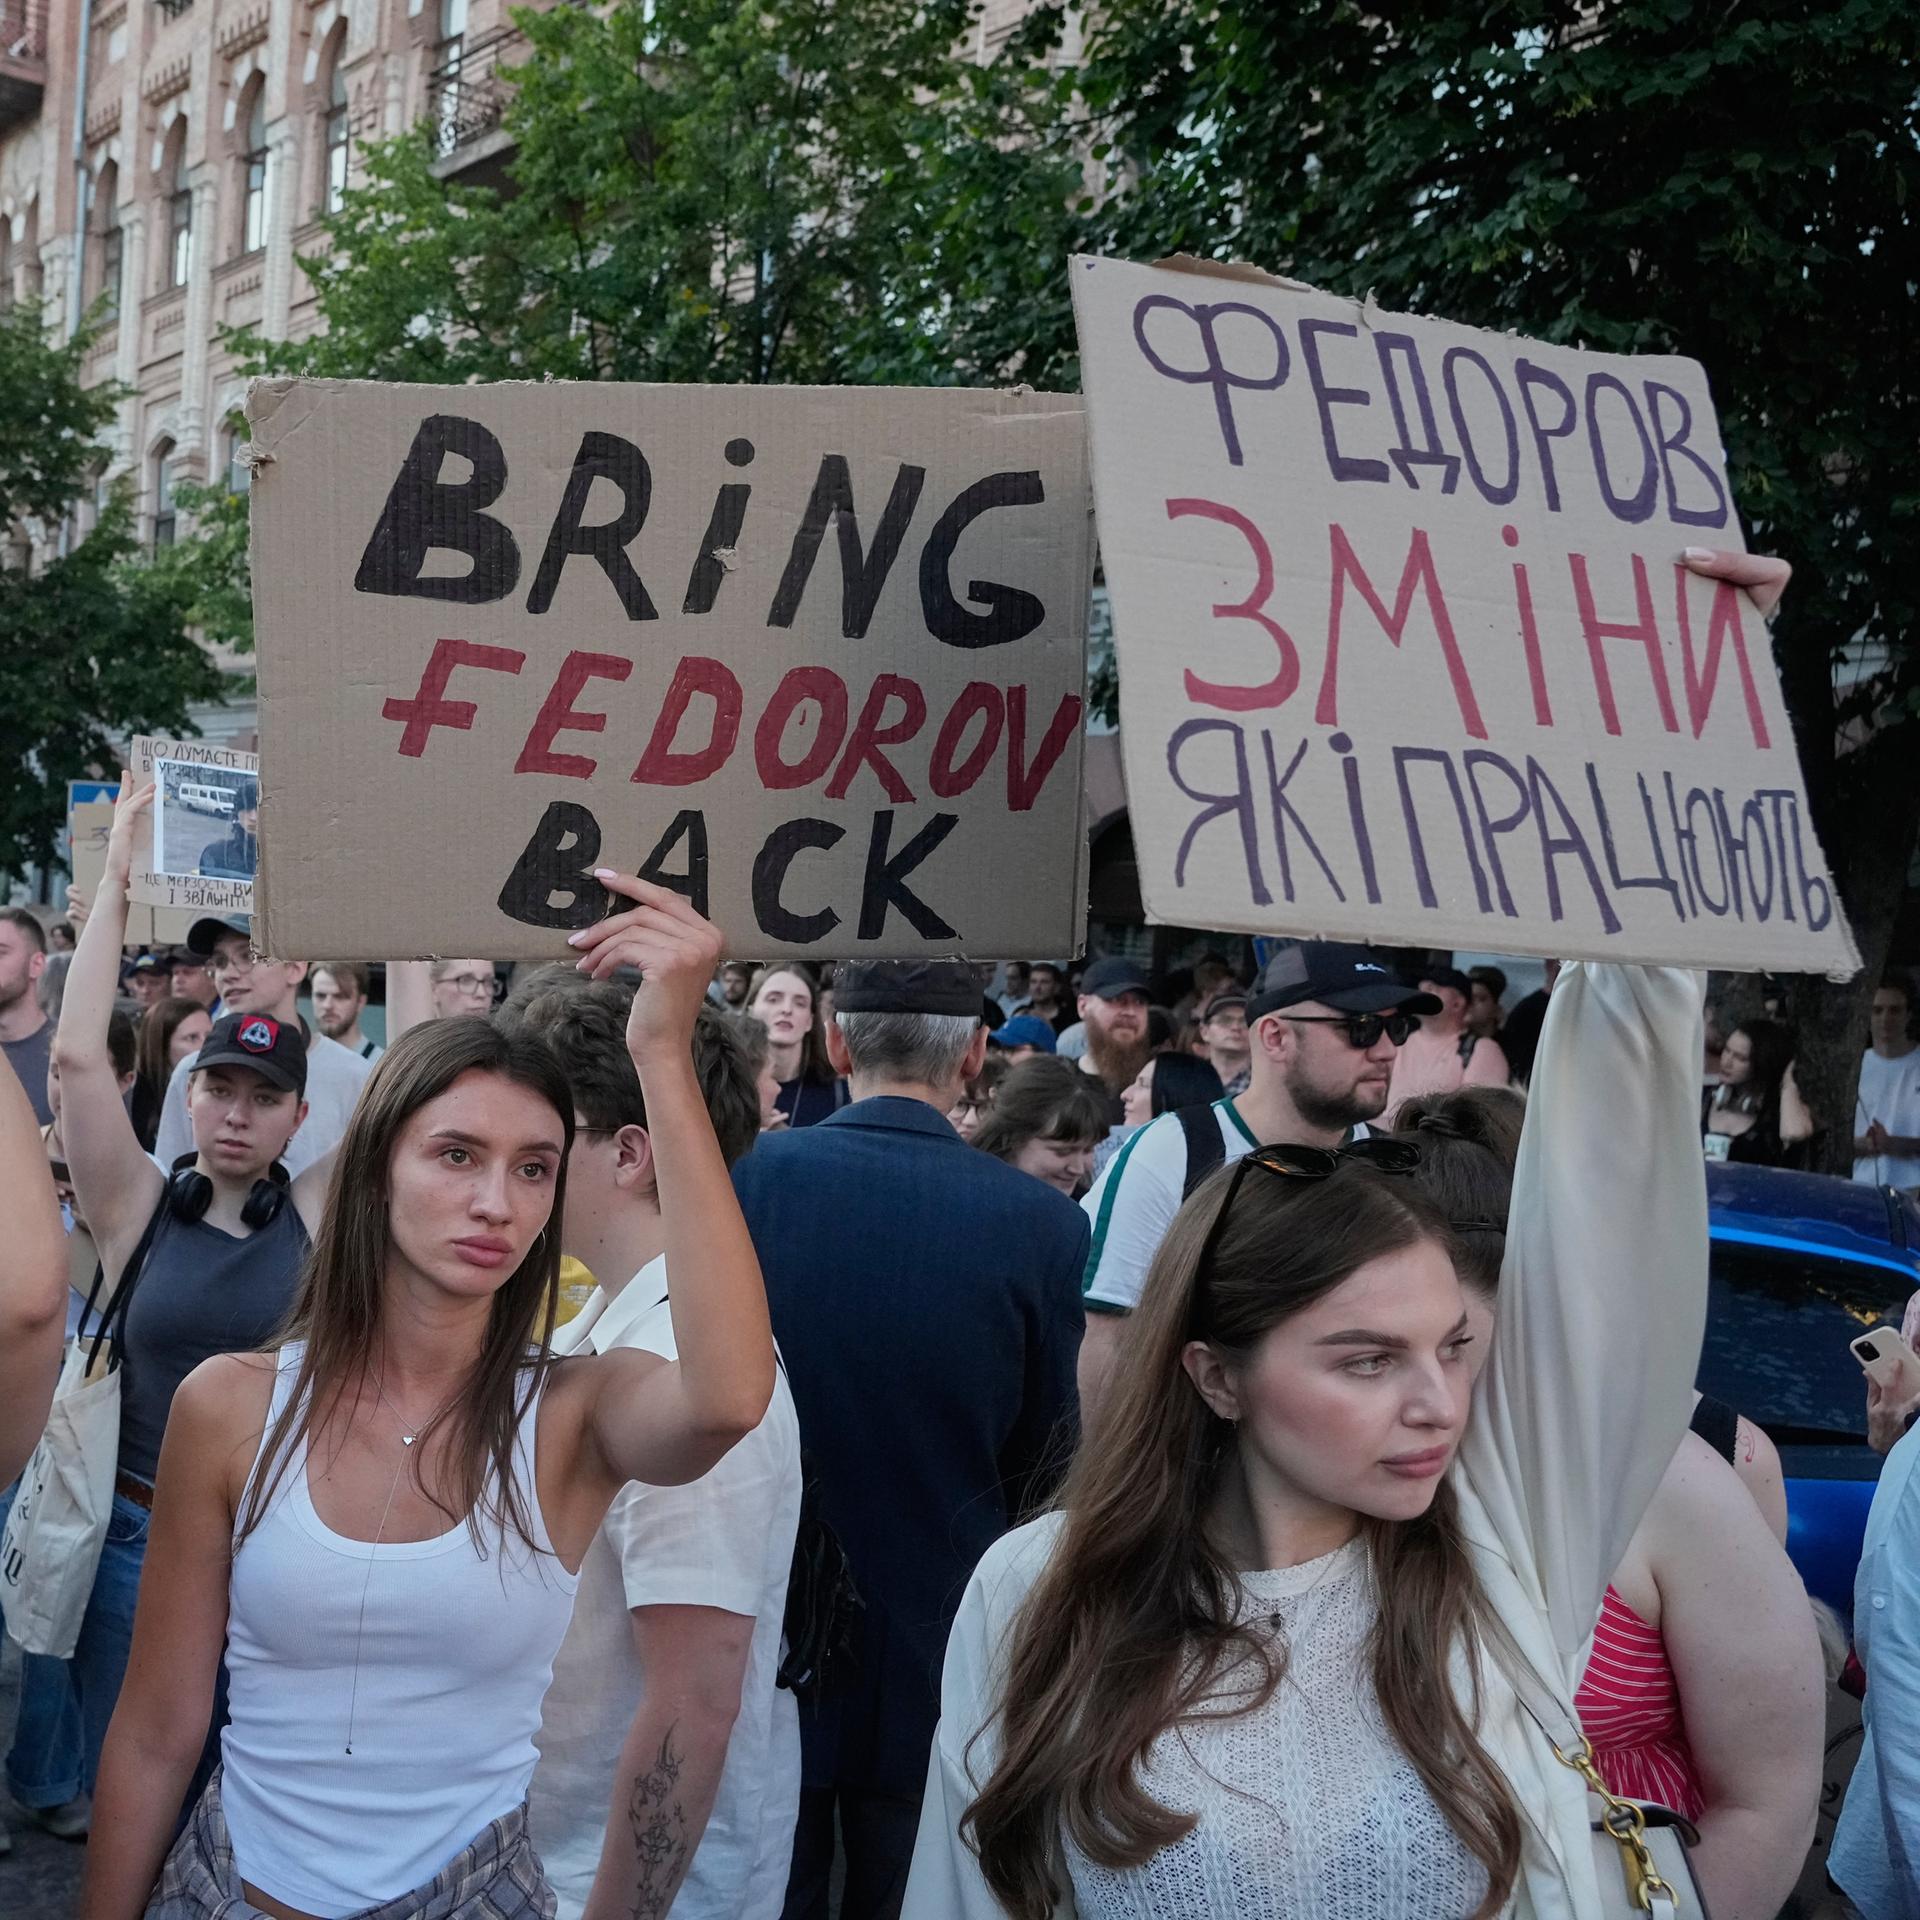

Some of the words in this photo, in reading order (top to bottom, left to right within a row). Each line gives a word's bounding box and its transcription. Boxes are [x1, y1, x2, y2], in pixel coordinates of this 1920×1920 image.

[1133, 294, 1729, 528] ФЕДОРОВ
[141, 740, 168, 760] ЩО
[381, 638, 1081, 812] FEDOROV
[497, 800, 962, 943] BACK
